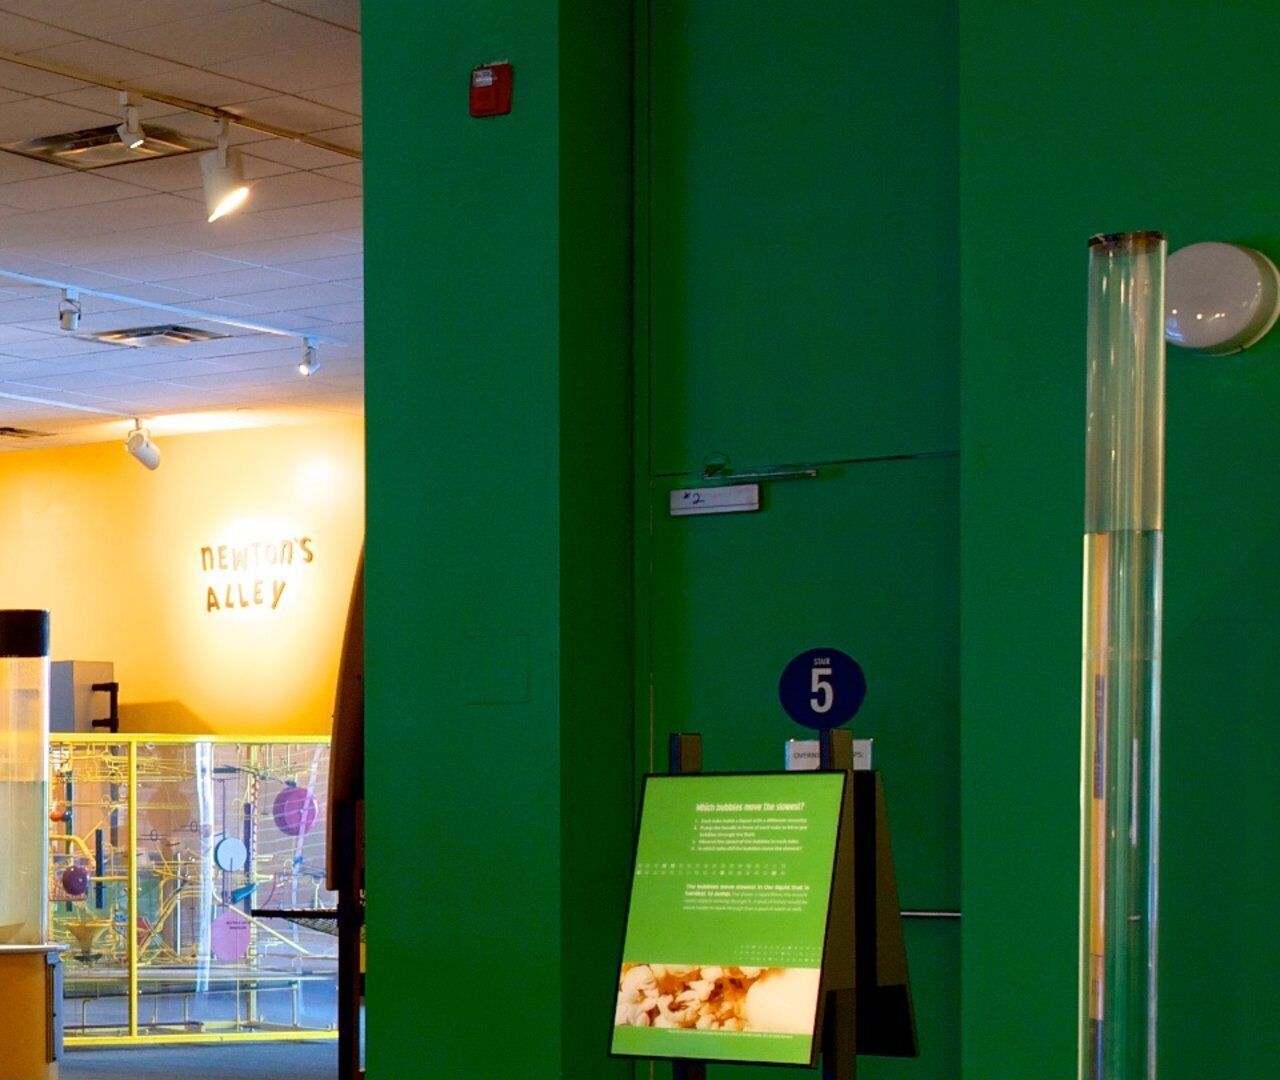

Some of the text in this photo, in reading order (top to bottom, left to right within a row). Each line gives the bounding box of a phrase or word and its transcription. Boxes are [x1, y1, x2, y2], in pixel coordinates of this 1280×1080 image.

[201, 537, 314, 571] NEWTON'S
[207, 580, 286, 612] ALLEY
[810, 668, 833, 713] 5
